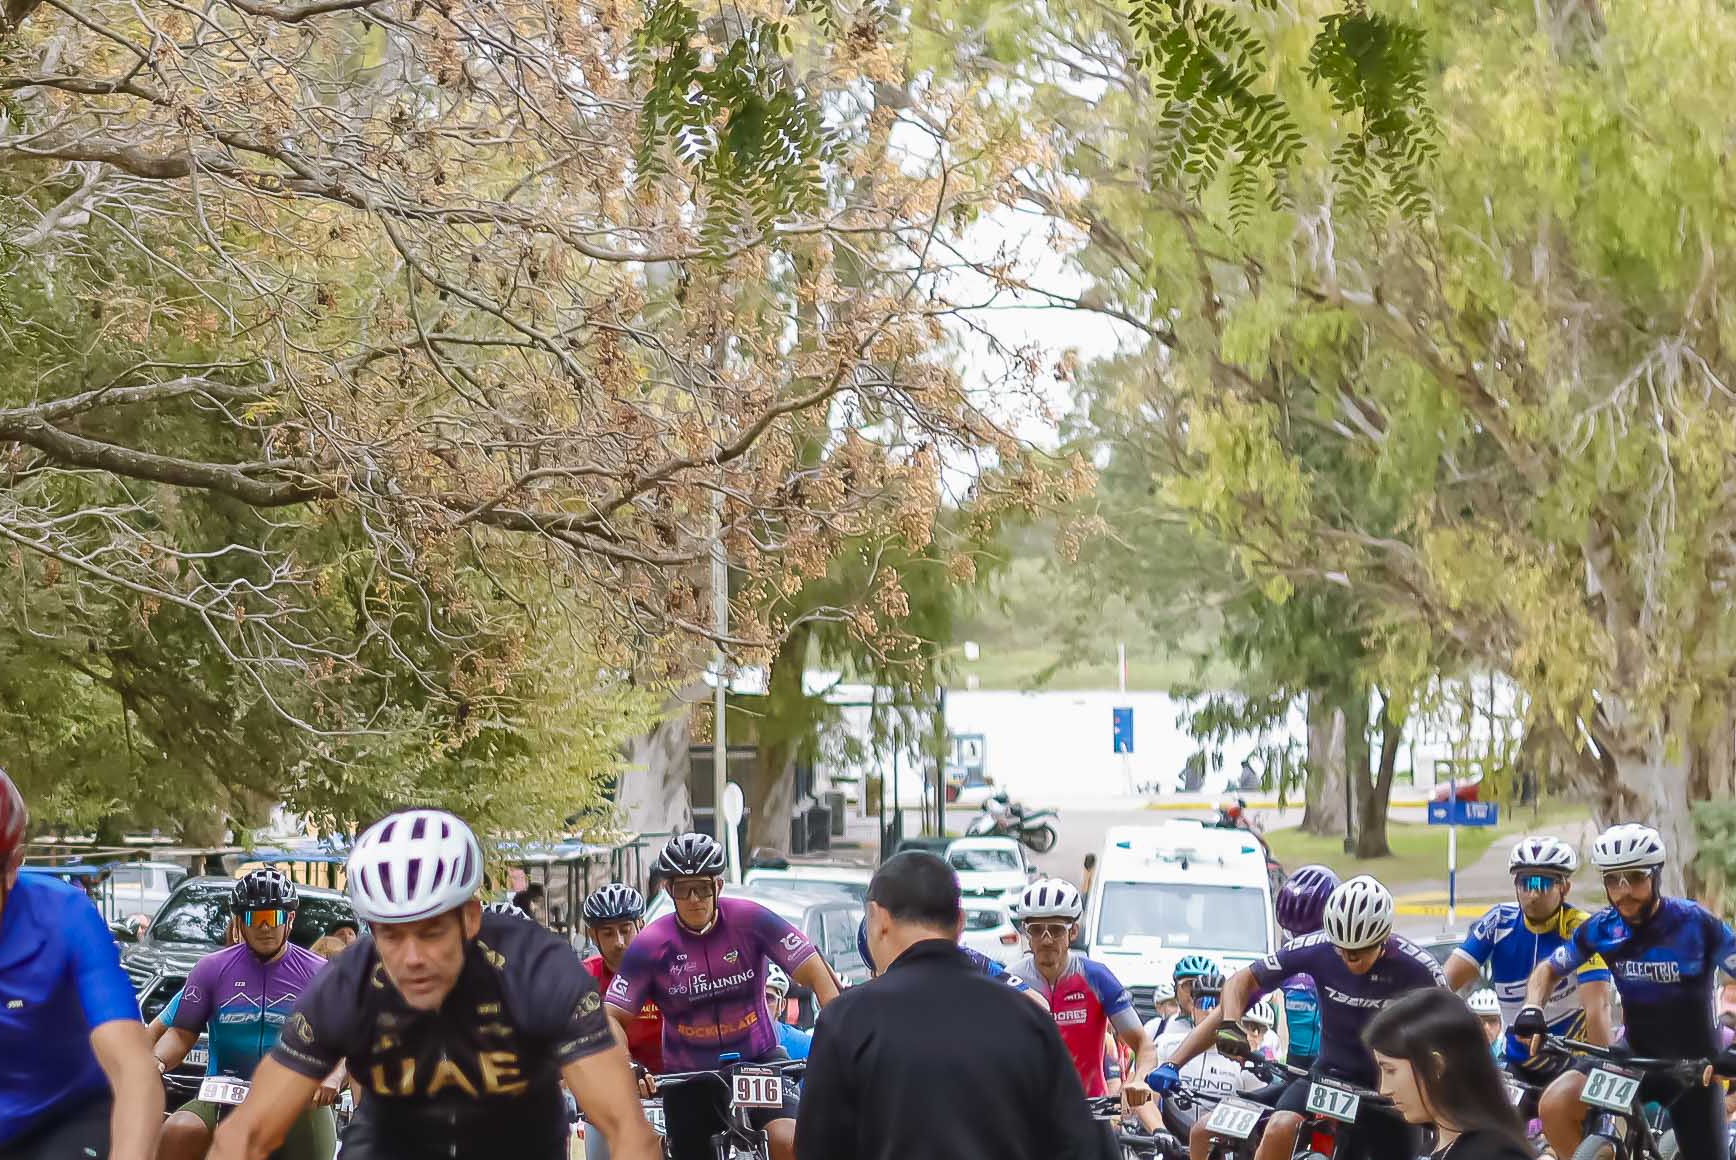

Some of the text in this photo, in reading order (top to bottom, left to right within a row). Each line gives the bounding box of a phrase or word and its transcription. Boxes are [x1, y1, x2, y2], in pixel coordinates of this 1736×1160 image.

[694, 968, 755, 994] TRAINING
[370, 1051, 530, 1097] UAE
[1179, 1074, 1233, 1091] RONO
[204, 1083, 245, 1102] 918
[737, 1077, 778, 1102] 916
[1312, 1086, 1356, 1115] 817
[1587, 1072, 1633, 1103] 814
[1212, 1105, 1255, 1132] 818
